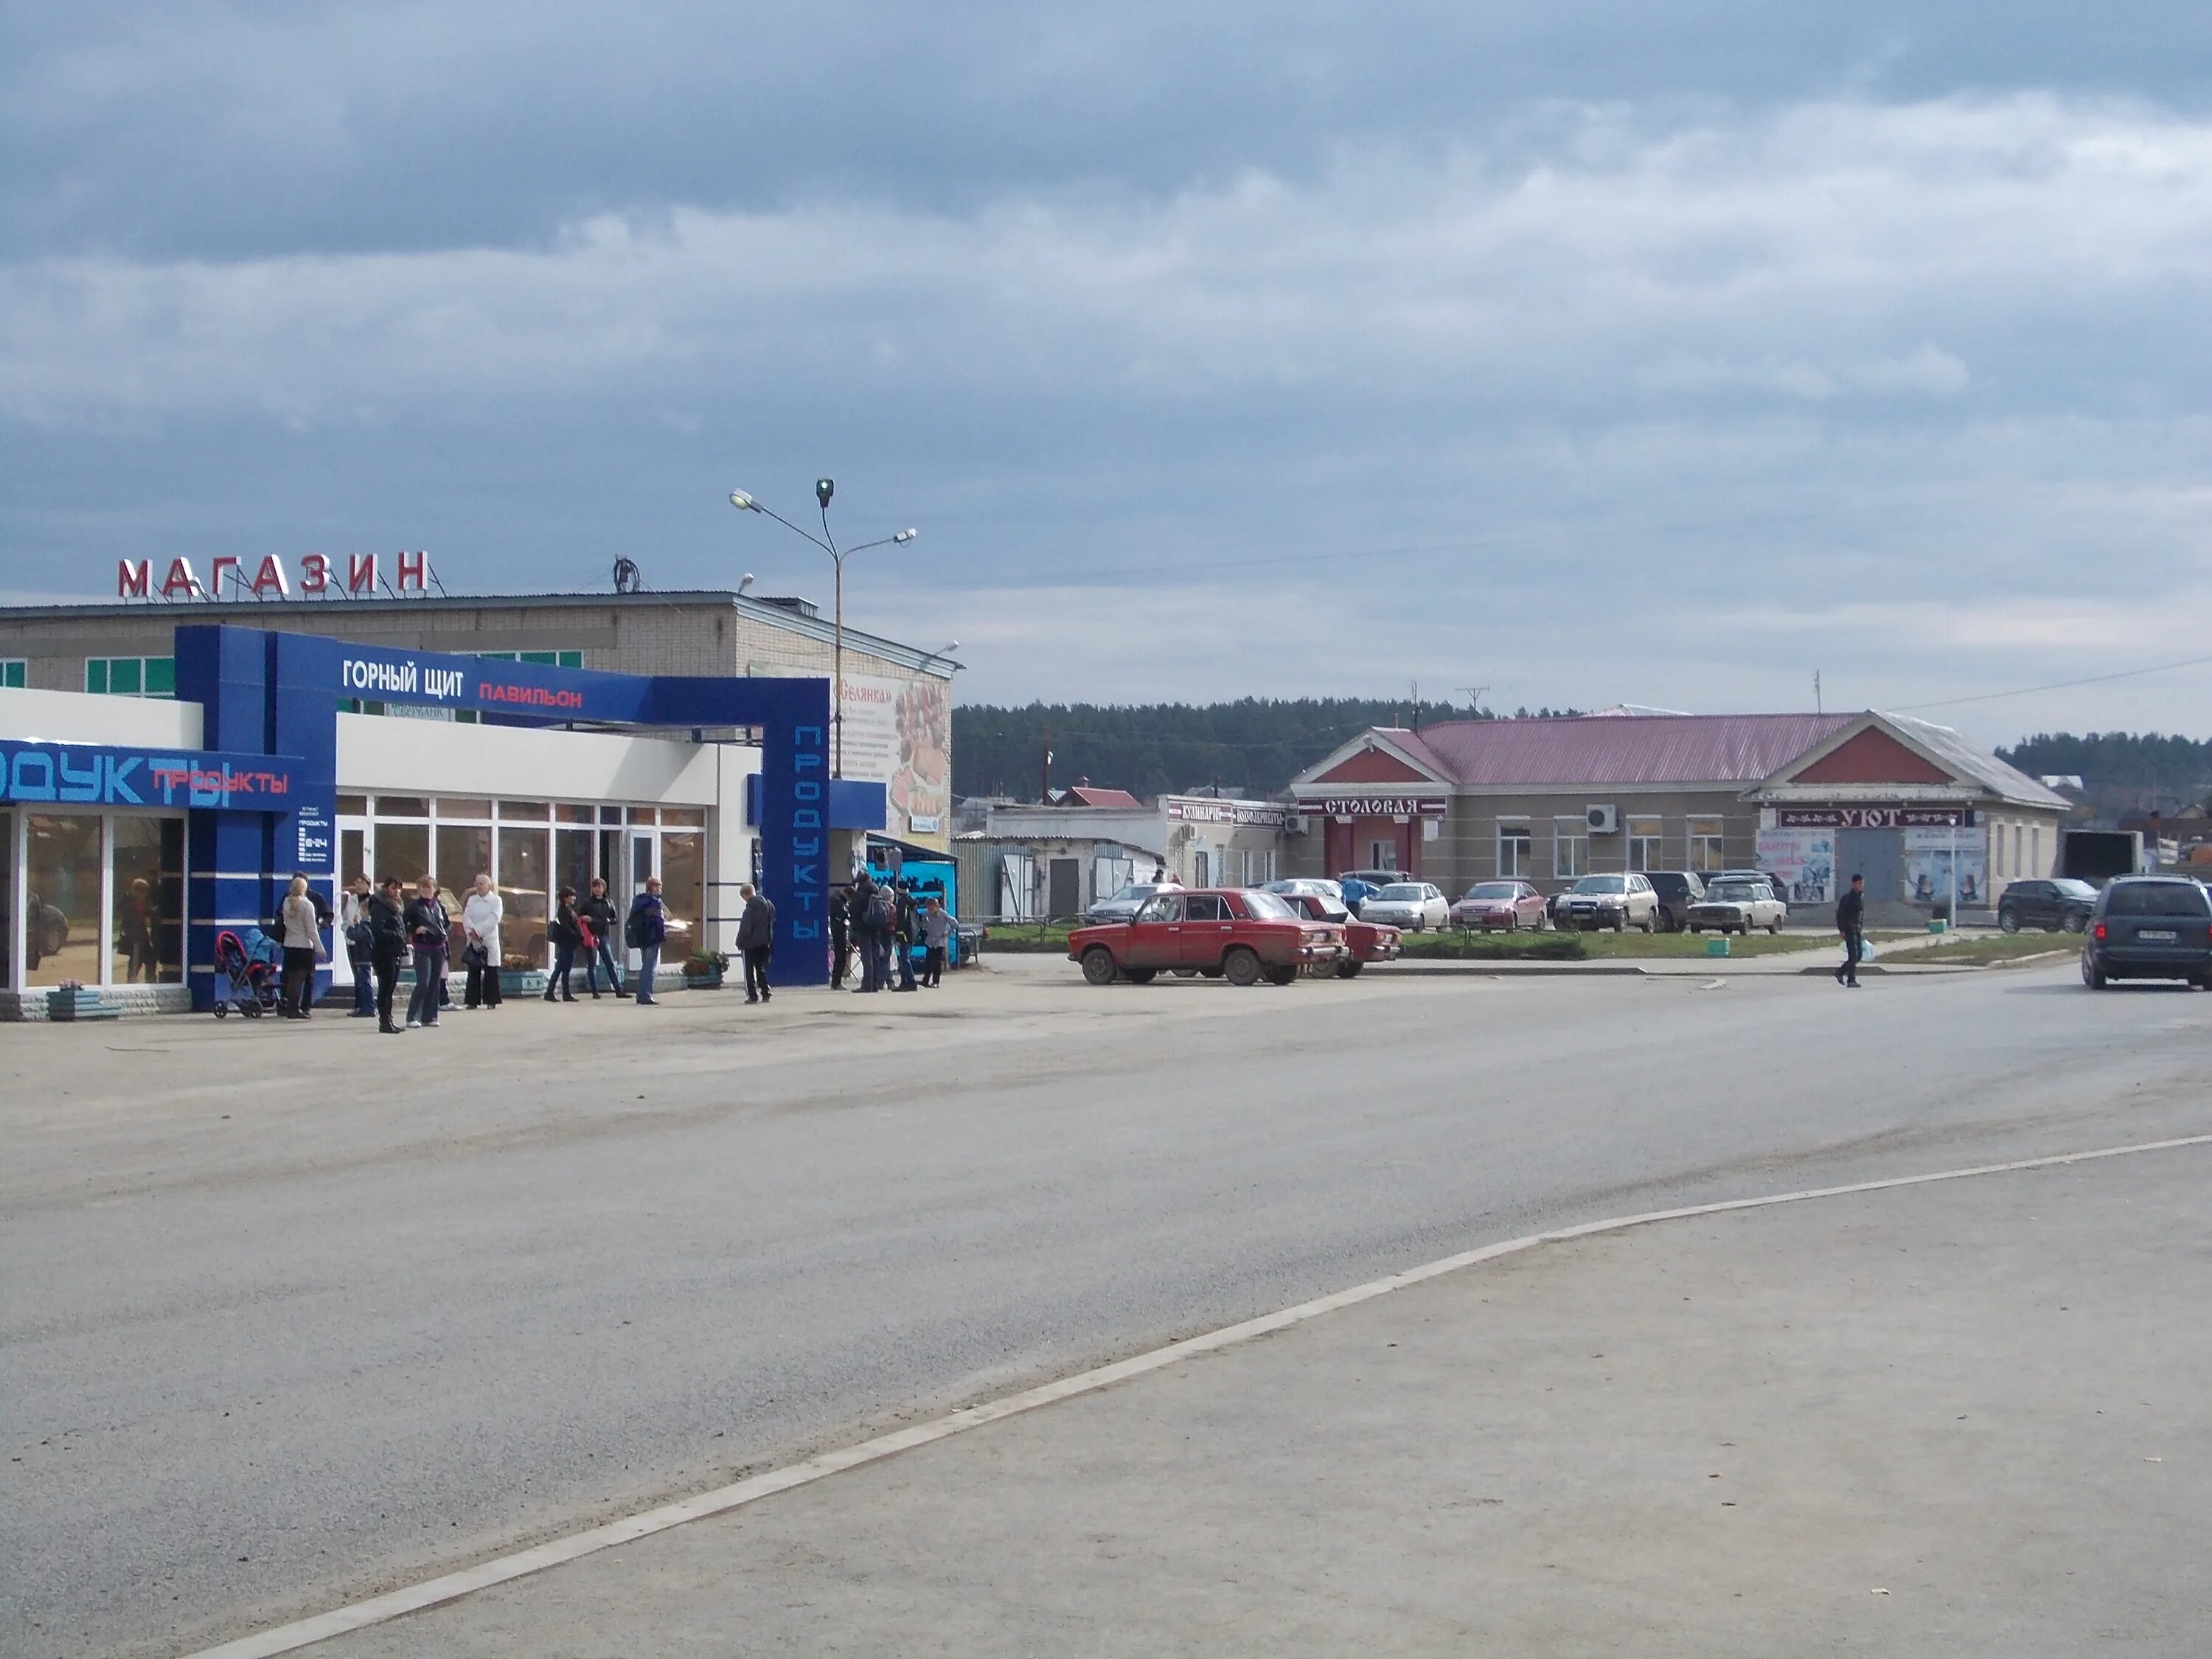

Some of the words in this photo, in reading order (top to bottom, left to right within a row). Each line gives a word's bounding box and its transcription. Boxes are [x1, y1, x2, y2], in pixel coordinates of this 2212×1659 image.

[118, 550, 428, 598] МАГАЗИН
[343, 661, 417, 693] ГОРНЫЙ
[425, 668, 465, 700] ЩИТ
[479, 683, 582, 709] ПАВИЛЬОН
[0, 751, 230, 808] ДУКТЫ
[153, 769, 288, 794] ПРОДУКТЫ
[1326, 799, 1418, 814] СТОЛОВАЯ
[1841, 809, 1901, 827] УЮТ
[793, 726, 822, 939] ПРОДУКТЫ
